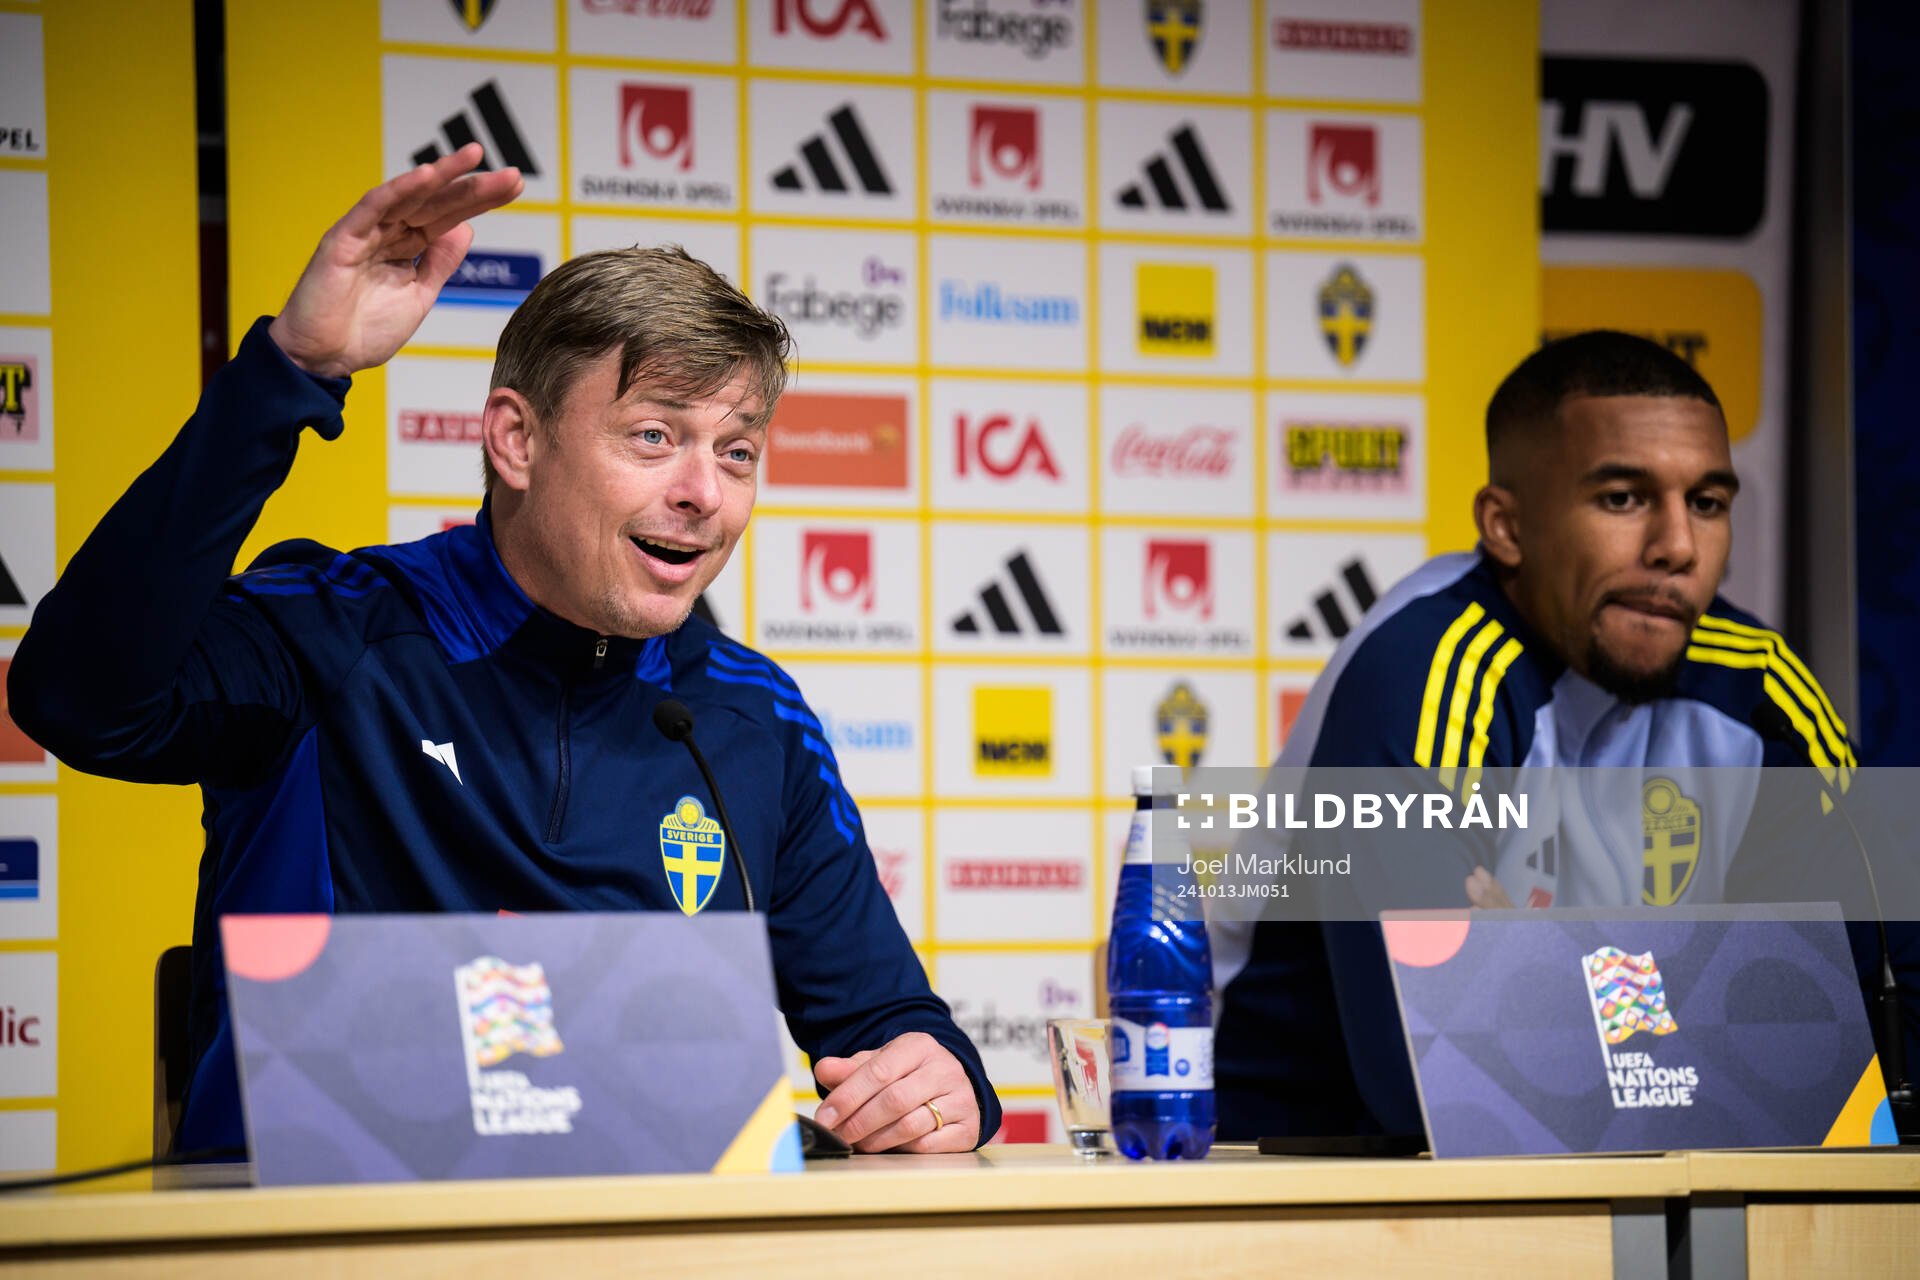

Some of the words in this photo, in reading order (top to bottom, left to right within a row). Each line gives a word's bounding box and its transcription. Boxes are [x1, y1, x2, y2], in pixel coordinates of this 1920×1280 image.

[955, 411, 1062, 484] ICA
[667, 829, 714, 844] SVERIGE
[1612, 1052, 1655, 1069] UEFA
[1607, 1065, 1700, 1089] NATIONS
[1611, 1086, 1694, 1109] LEAGUE
